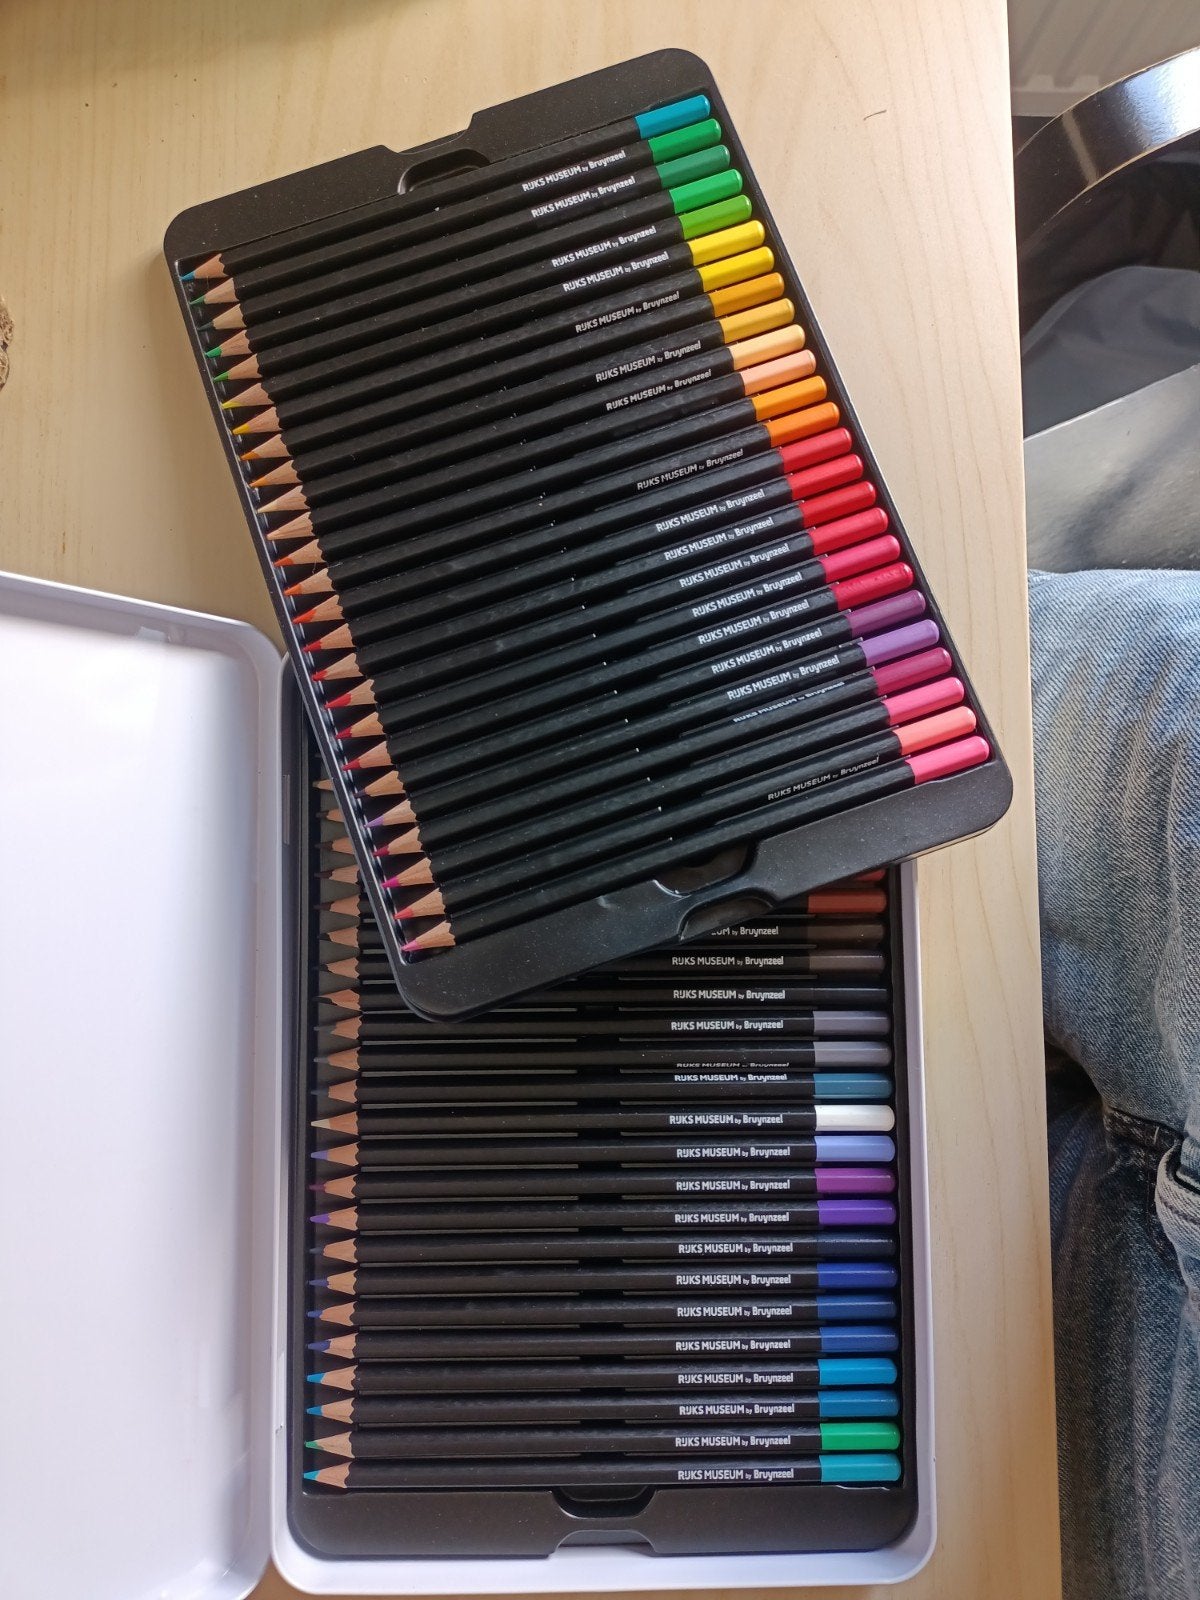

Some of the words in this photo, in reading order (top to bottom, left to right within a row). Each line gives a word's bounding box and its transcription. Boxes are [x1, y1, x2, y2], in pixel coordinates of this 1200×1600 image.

[544, 165, 582, 184] MUSEUM
[588, 149, 626, 169] Bruynzeel
[553, 190, 591, 210] MUSEUM
[597, 175, 636, 195] Bruynzeel
[574, 240, 612, 259] MUSEUM
[618, 225, 657, 245] Bruynzeel
[585, 265, 624, 284] MUSEUM
[630, 250, 669, 270] Bruynzeel
[598, 306, 635, 325] MUSEUM
[642, 290, 680, 311] Bruynzeel
[619, 355, 656, 374] MUSEUM
[663, 339, 701, 360] Bruynzeel
[629, 384, 666, 403] MUSEUM
[674, 368, 712, 388] Bruynzeel
[660, 463, 698, 482] MUSEUM
[706, 448, 743, 467] Bruynzeel
[679, 504, 719, 524] MUSEUM
[725, 488, 765, 509] Bruynzeel
[688, 532, 728, 552] MUSEUM
[733, 516, 774, 537] Bruynzeel
[703, 559, 743, 579] MUSEUM
[749, 543, 790, 564] Bruynzeel
[716, 588, 756, 609] MUSEUM
[762, 571, 803, 593] Bruynzeel
[722, 615, 762, 636] MUSEUM
[769, 599, 810, 620] Bruynzeel
[735, 644, 775, 665] MUSEUM
[781, 627, 823, 649] Bruynzeel
[751, 671, 792, 692] MUSEUM
[798, 654, 840, 676] Bruynzeel
[792, 774, 831, 792] MUSEUM
[739, 925, 779, 938] Bruynzeel
[697, 956, 735, 965] MUSEUM
[744, 955, 784, 968] Bruynzeel
[698, 989, 736, 999] MUSEUM
[746, 989, 785, 1002] Bruynzeel
[696, 1020, 735, 1030] MUSEUM
[743, 1019, 784, 1031] Bruynzeel
[747, 1073, 787, 1082] Bruynzeel
[694, 1114, 734, 1124] MUSEUM
[742, 1113, 784, 1126] Bruynzeel
[702, 1147, 741, 1157] MUSEUM
[741, 1150, 749, 1158] by
[750, 1146, 791, 1158] Bruynzeel
[701, 1180, 741, 1190] MUSEUM
[741, 1183, 749, 1191] by
[750, 1179, 790, 1191] Bruynzeel
[700, 1213, 739, 1223] MUSEUM
[748, 1211, 789, 1224] Bruynzeel
[704, 1243, 743, 1253] MUSEUM
[744, 1246, 751, 1254] by
[752, 1242, 793, 1255] Bruynzeel
[702, 1274, 741, 1285] MUSEUM
[742, 1278, 750, 1286] by
[751, 1274, 791, 1286] Bruynzeel
[702, 1306, 742, 1317] MUSEUM
[752, 1304, 792, 1318] Bruynzeel
[701, 1340, 741, 1350] MUSEUM
[741, 1343, 749, 1351] by
[750, 1339, 791, 1351] Bruynzeel
[704, 1373, 743, 1384] MUSEUM
[753, 1372, 794, 1385] Bruynzeel
[705, 1404, 745, 1415] MUSEUM
[745, 1407, 753, 1415] by
[754, 1403, 795, 1415] Bruynzeel
[701, 1436, 740, 1446] MUSEUM
[741, 1439, 749, 1447] by
[750, 1434, 791, 1448] Bruynzeel
[704, 1469, 743, 1480] MUSEUM
[753, 1468, 794, 1481] Bruynzeel
